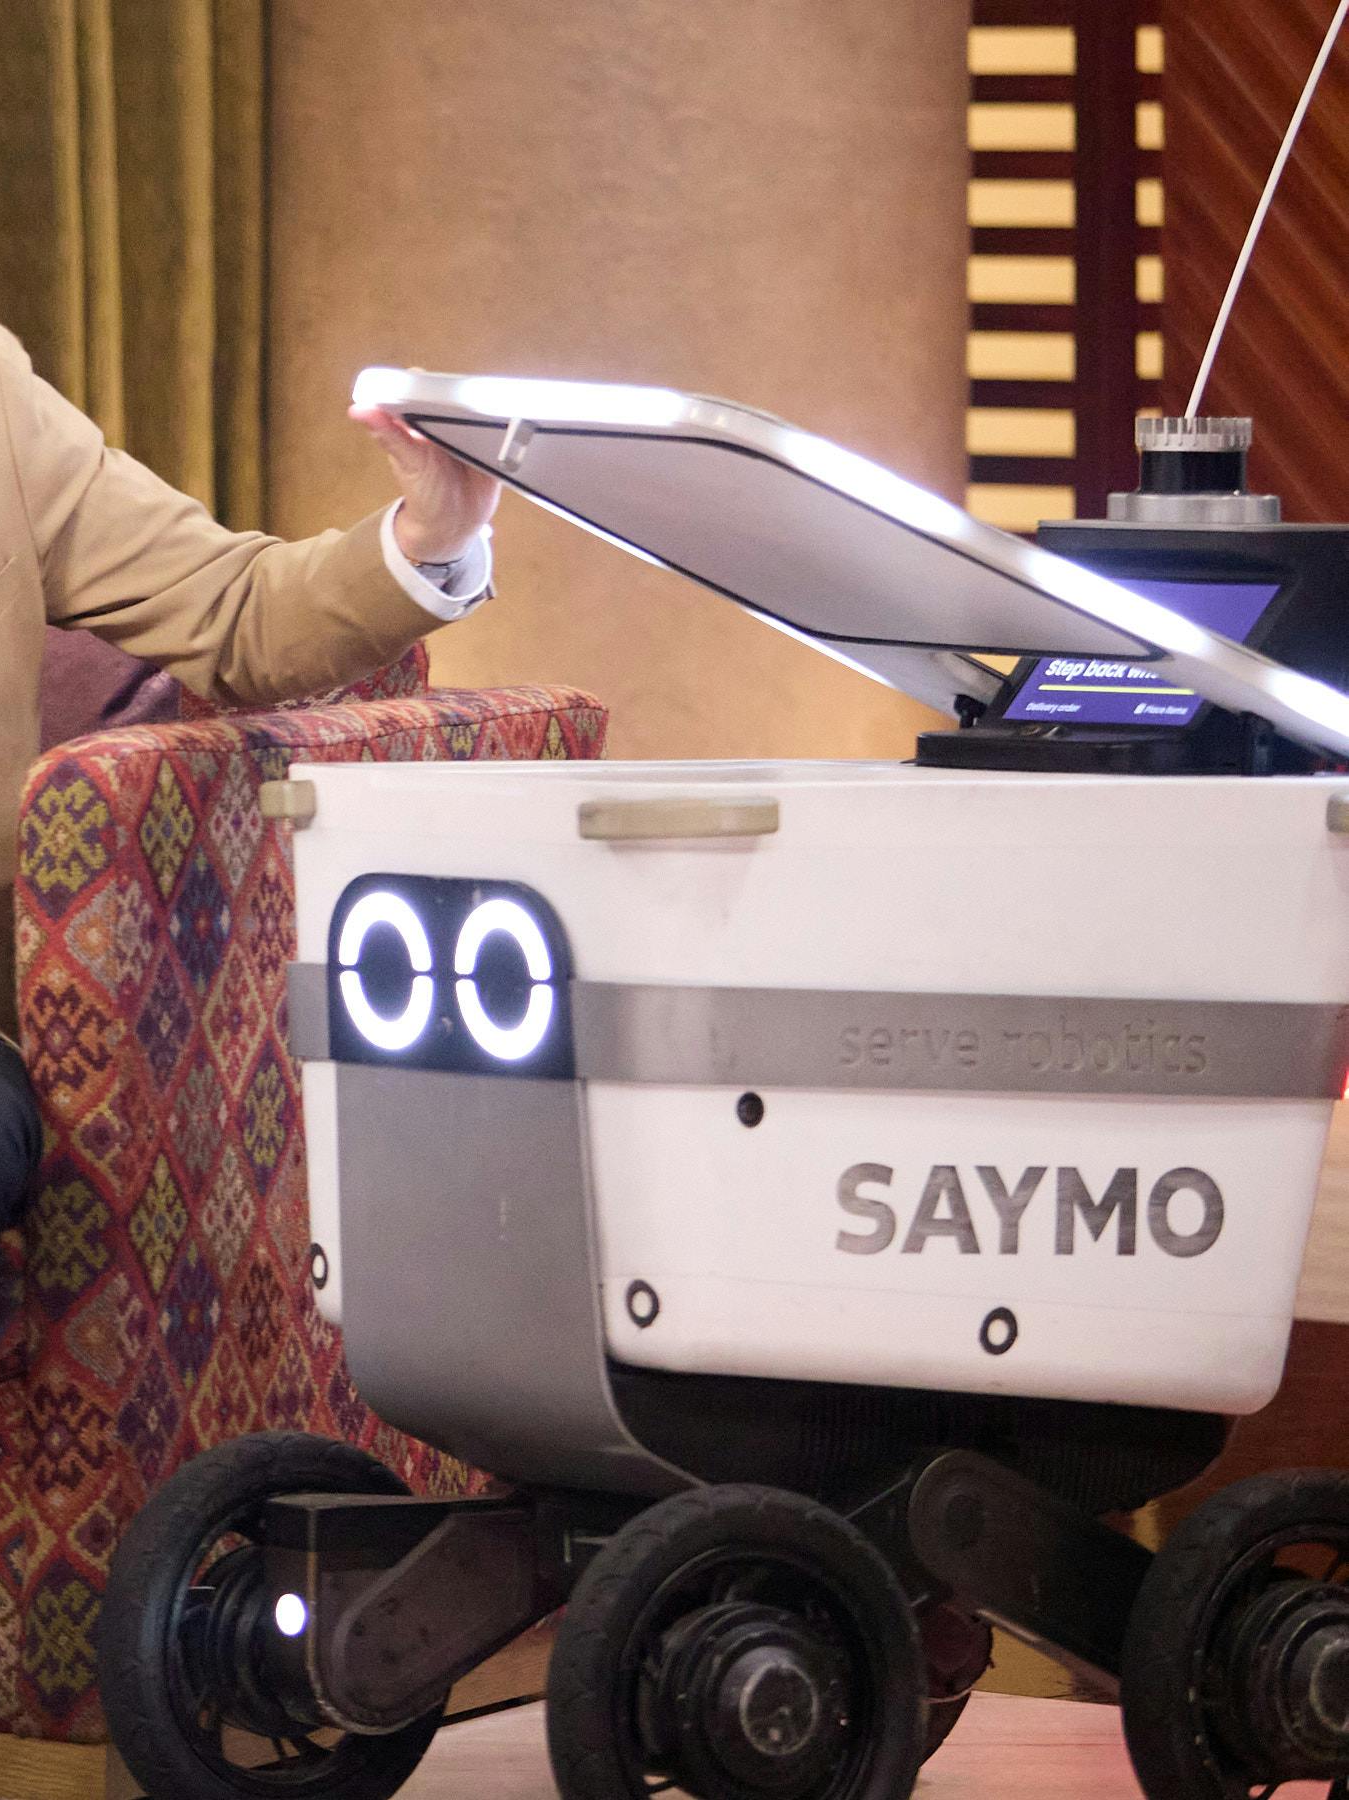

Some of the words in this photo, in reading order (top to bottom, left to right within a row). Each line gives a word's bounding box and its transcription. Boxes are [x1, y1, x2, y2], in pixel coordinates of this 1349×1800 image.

[1045, 659, 1087, 681] Step
[1083, 659, 1128, 678] back
[838, 1023, 980, 1069] serve
[1002, 1013, 1208, 1075] robotics
[834, 1161, 1226, 1259] SAYMO
